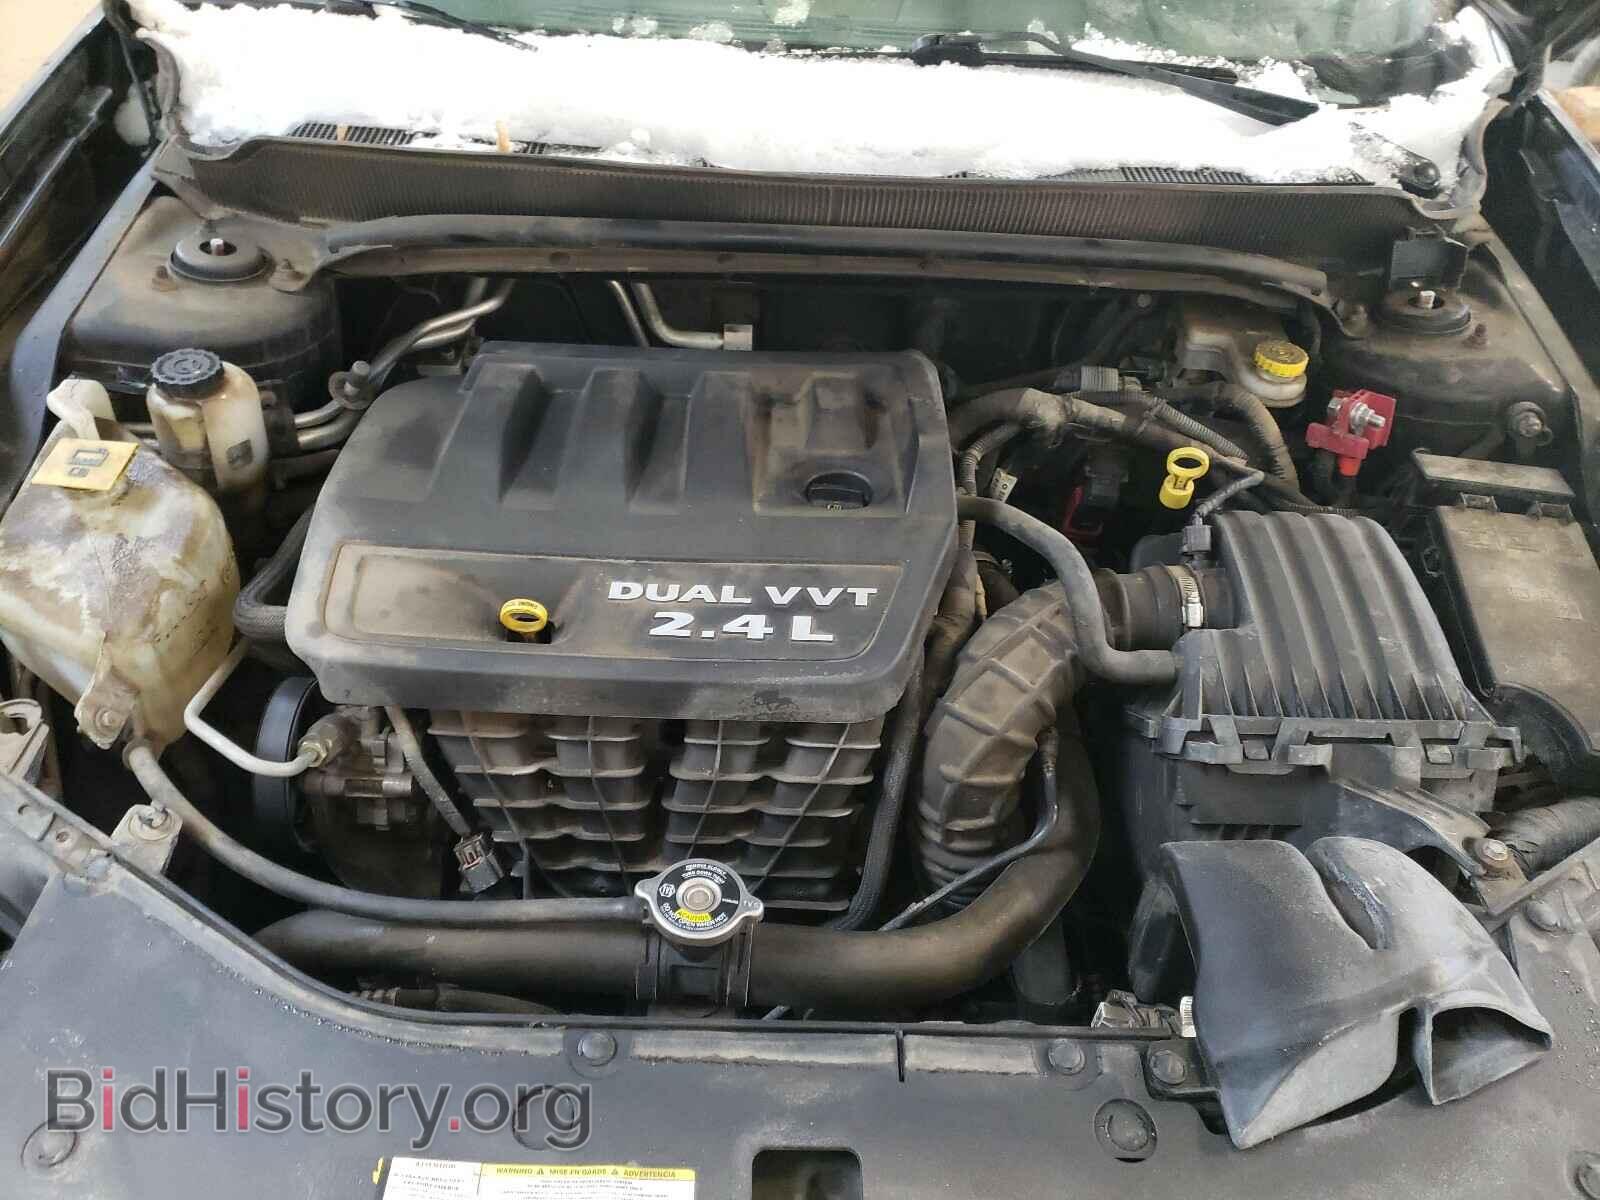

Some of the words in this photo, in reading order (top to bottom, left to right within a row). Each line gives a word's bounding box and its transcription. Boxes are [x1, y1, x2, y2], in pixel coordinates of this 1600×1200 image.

[608, 581, 752, 604] DUAL
[765, 586, 878, 606] VVT
[648, 611, 774, 640] 2.4
[791, 615, 834, 642] L
[678, 918, 695, 927] OPEN
[696, 919, 715, 928] WHEN
[714, 911, 727, 922] HOT
[623, 1169, 676, 1178] ADVERTENCIA
